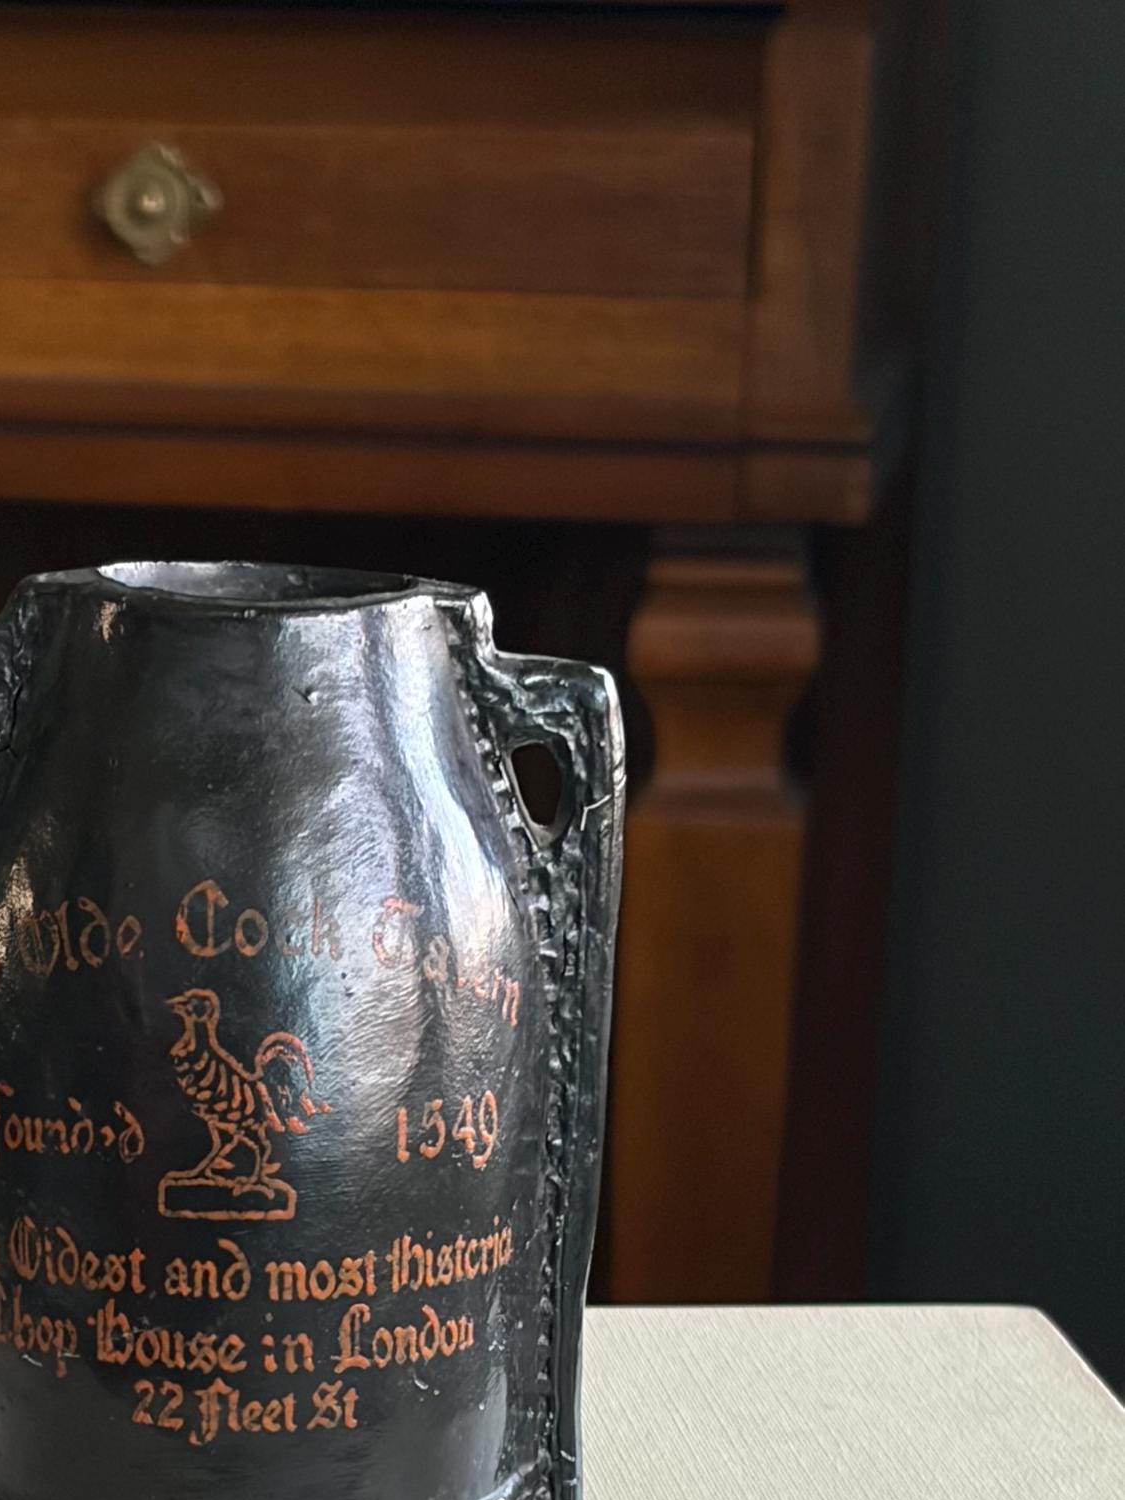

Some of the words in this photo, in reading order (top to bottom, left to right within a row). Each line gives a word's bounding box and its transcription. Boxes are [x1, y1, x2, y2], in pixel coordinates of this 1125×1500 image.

[396, 1089, 497, 1169] 1549
[164, 1238, 252, 1301] and
[265, 1249, 377, 1301] most
[261, 1311, 315, 1374] in
[331, 1302, 475, 1374] London
[131, 1378, 185, 1431] 22
[187, 1376, 298, 1447] Fleet
[306, 1379, 359, 1431] St
